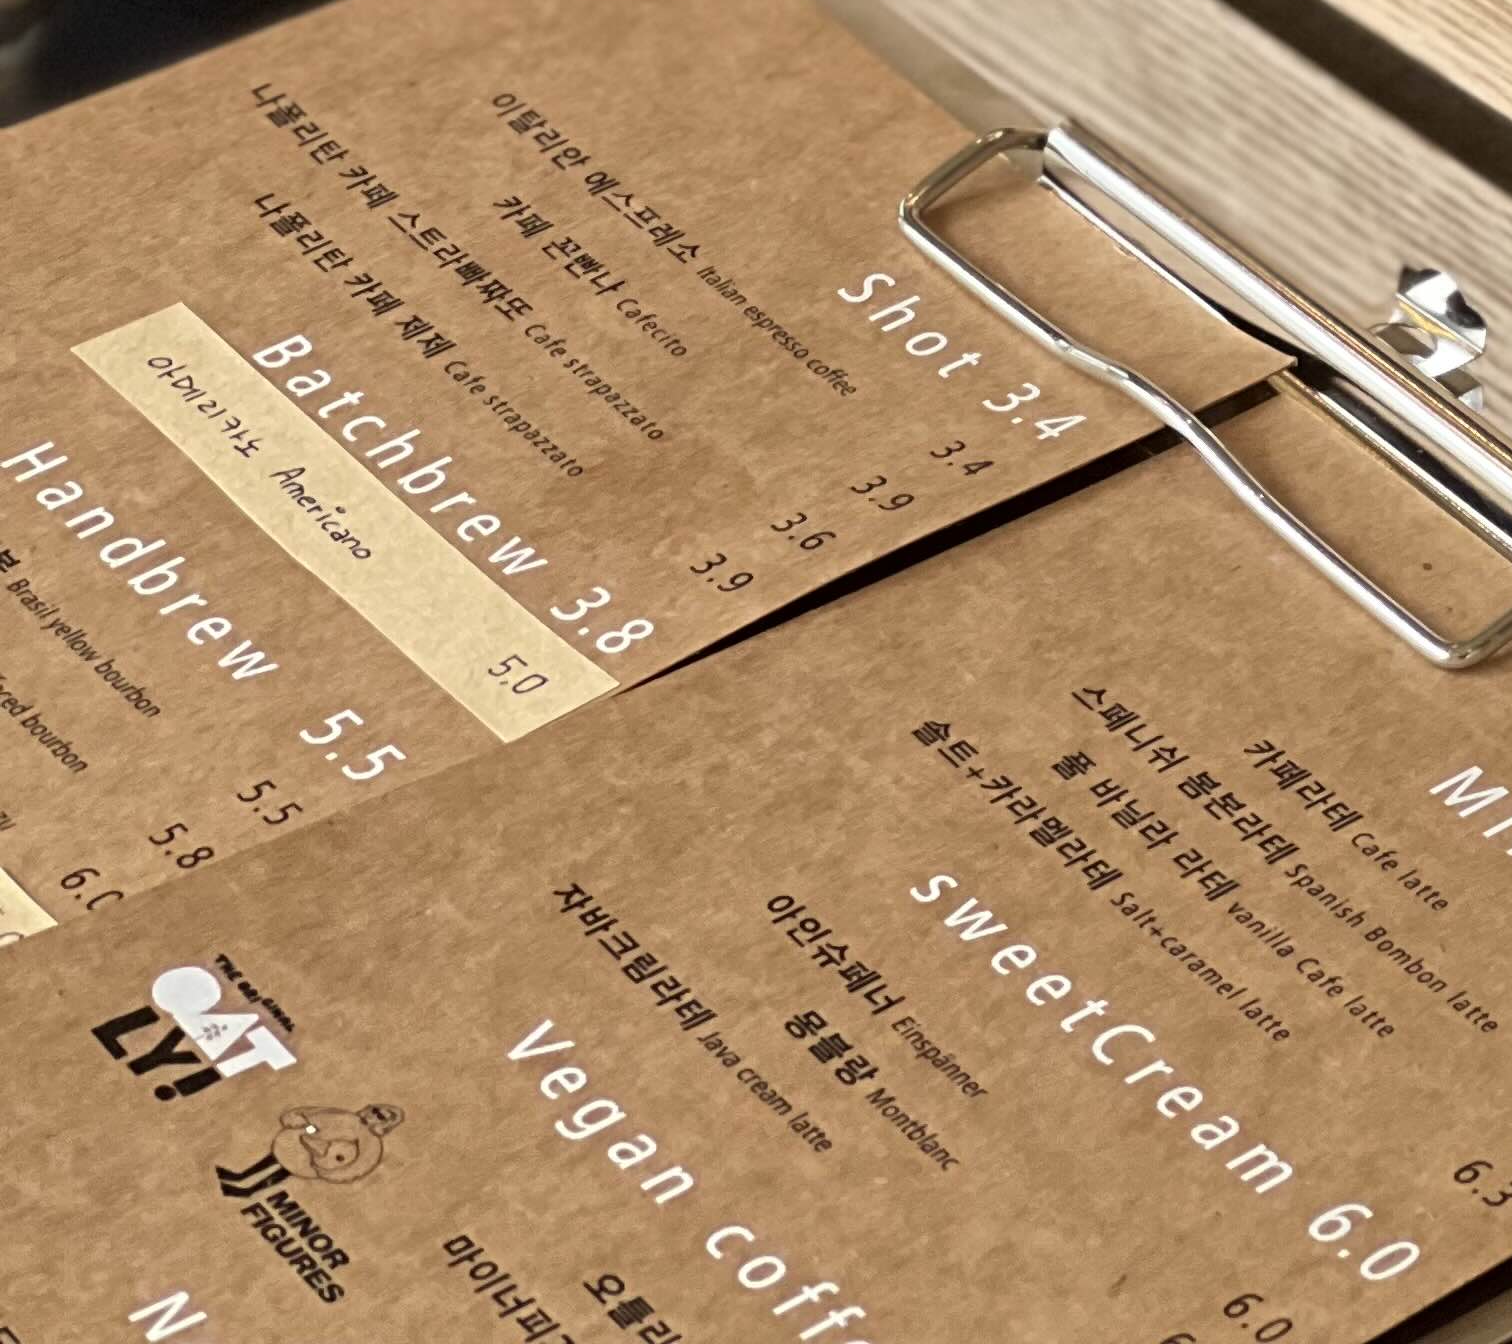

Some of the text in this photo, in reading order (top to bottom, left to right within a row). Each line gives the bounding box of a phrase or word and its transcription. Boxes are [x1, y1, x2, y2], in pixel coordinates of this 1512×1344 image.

[252, 84, 349, 165] 나폴리탄
[339, 165, 399, 210] 카페
[525, 323, 567, 358] Cafe
[563, 357, 664, 441] strapazzato
[770, 512, 836, 551] 3.6
[254, 193, 353, 273] 나폴리탄
[344, 272, 404, 318] 카페
[443, 359, 487, 395] Cafe
[483, 393, 585, 479] strapazzato
[689, 552, 754, 593] 3.9
[492, 93, 995, 477] 이탈리안 에스프레소 Italian espresso coffee 3.4
[493, 196, 554, 238] 카페
[615, 297, 688, 358] Cafecito
[850, 475, 915, 511] 3.9
[837, 273, 1087, 440] Shot 3.4
[0, 440, 406, 781] Handbrew 5.5
[253, 334, 654, 654] Batchbrew 3.8
[269, 467, 371, 560] Americano
[487, 654, 549, 695] 5.0
[6, 578, 303, 826] Brasil yellow bourbon 5.5
[20, 712, 88, 773] bourbon
[148, 822, 215, 870] 5.8
[1243, 739, 1364, 832] 카페라테
[1351, 832, 1398, 871] Cafe
[1397, 868, 1449, 911] latte
[1071, 687, 1190, 773] 스페니쉬
[1177, 771, 1300, 865] 봄본라테
[1284, 863, 1366, 928] Spanish
[1364, 926, 1448, 993] Bombon
[1446, 990, 1498, 1033] latte
[1089, 778, 1179, 850] 바닐라
[1172, 847, 1241, 902] 라테
[1226, 901, 1296, 958] vanilla
[1296, 957, 1344, 998] Cafe
[1343, 994, 1395, 1038] latte
[1110, 891, 1248, 1000] Salt+caramel
[1239, 997, 1291, 1042] latte
[552, 882, 833, 1153] 자바크림라테 Java cream latte
[767, 895, 906, 1016] 아인슈페너
[1223, 1293, 1293, 1343] 6.0
[784, 1010, 960, 1172] 몽블랑 Montblanc
[909, 873, 1420, 1281] sweetCream 6.0
[240, 1202, 345, 1303] FIGURES
[266, 1190, 350, 1270] MINOR
[443, 1235, 575, 1344] 마이너피
[507, 1019, 872, 1344] Vegan coff
